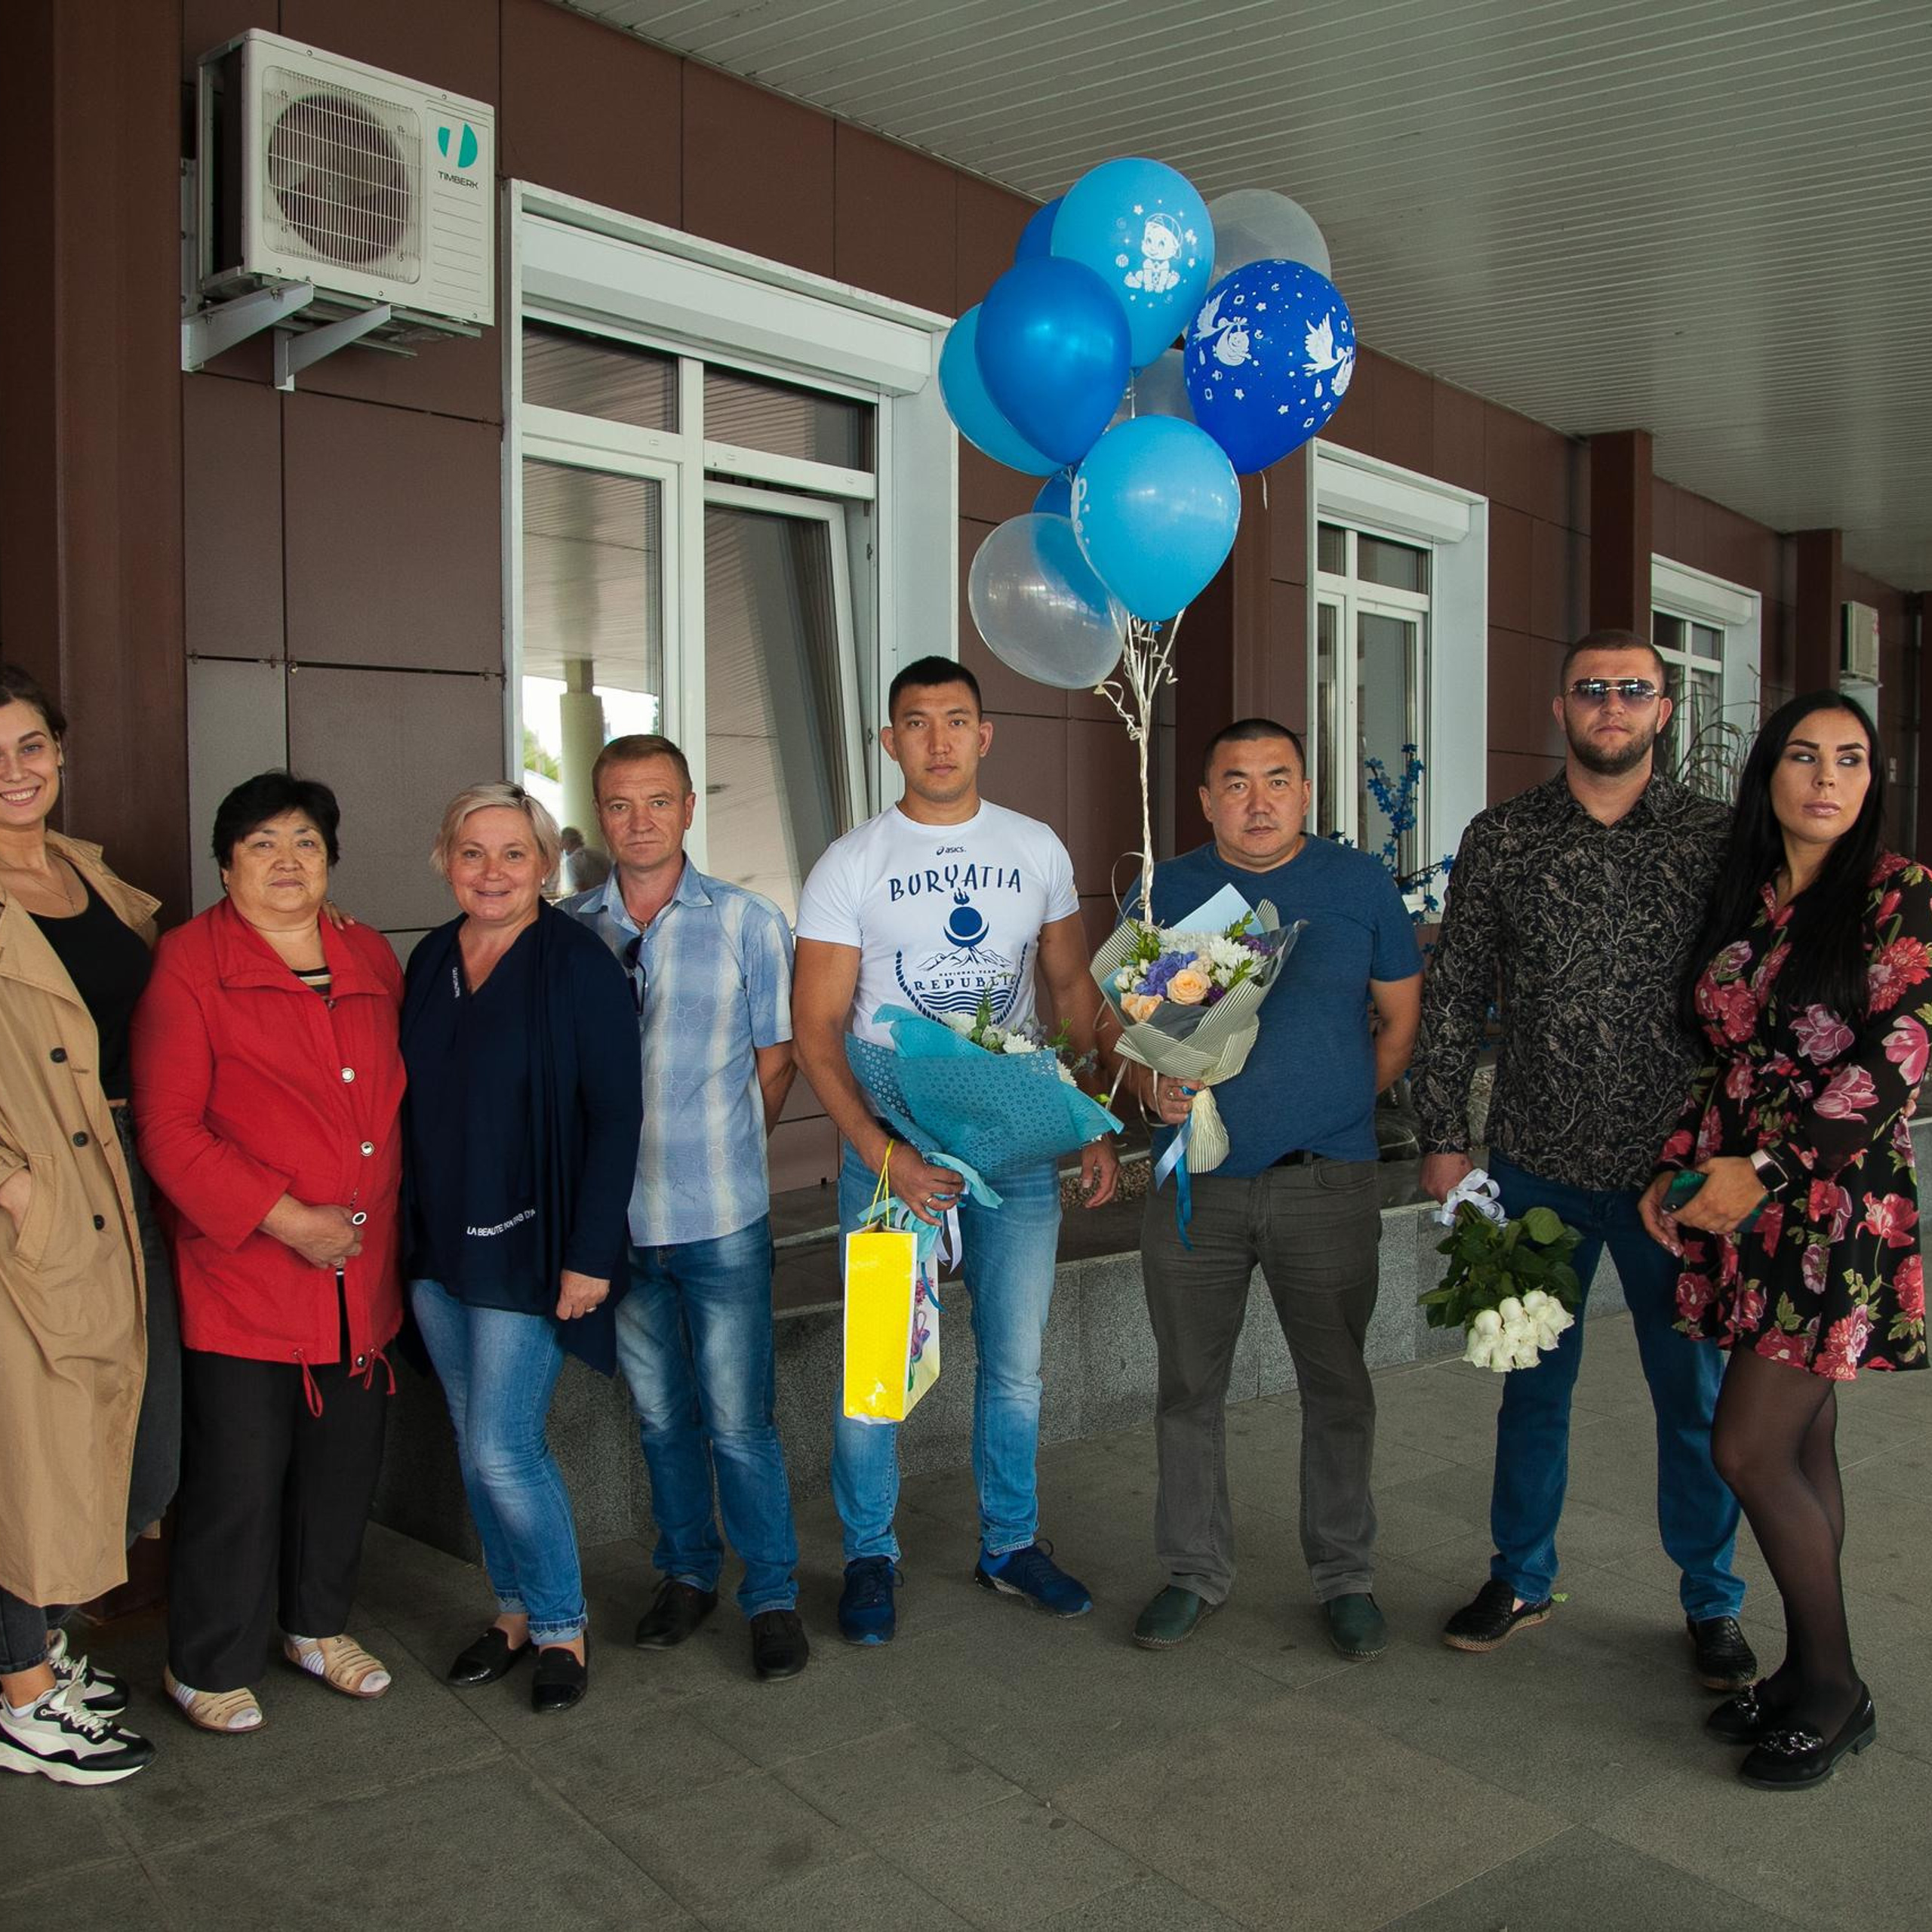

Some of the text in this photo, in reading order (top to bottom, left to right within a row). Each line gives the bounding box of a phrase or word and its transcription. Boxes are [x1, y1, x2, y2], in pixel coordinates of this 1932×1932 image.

[438, 171, 478, 189] TIMBERK
[888, 863, 1021, 902] BURYATIA
[914, 975, 1017, 991] REPUBLIC
[466, 1226, 476, 1235] LA
